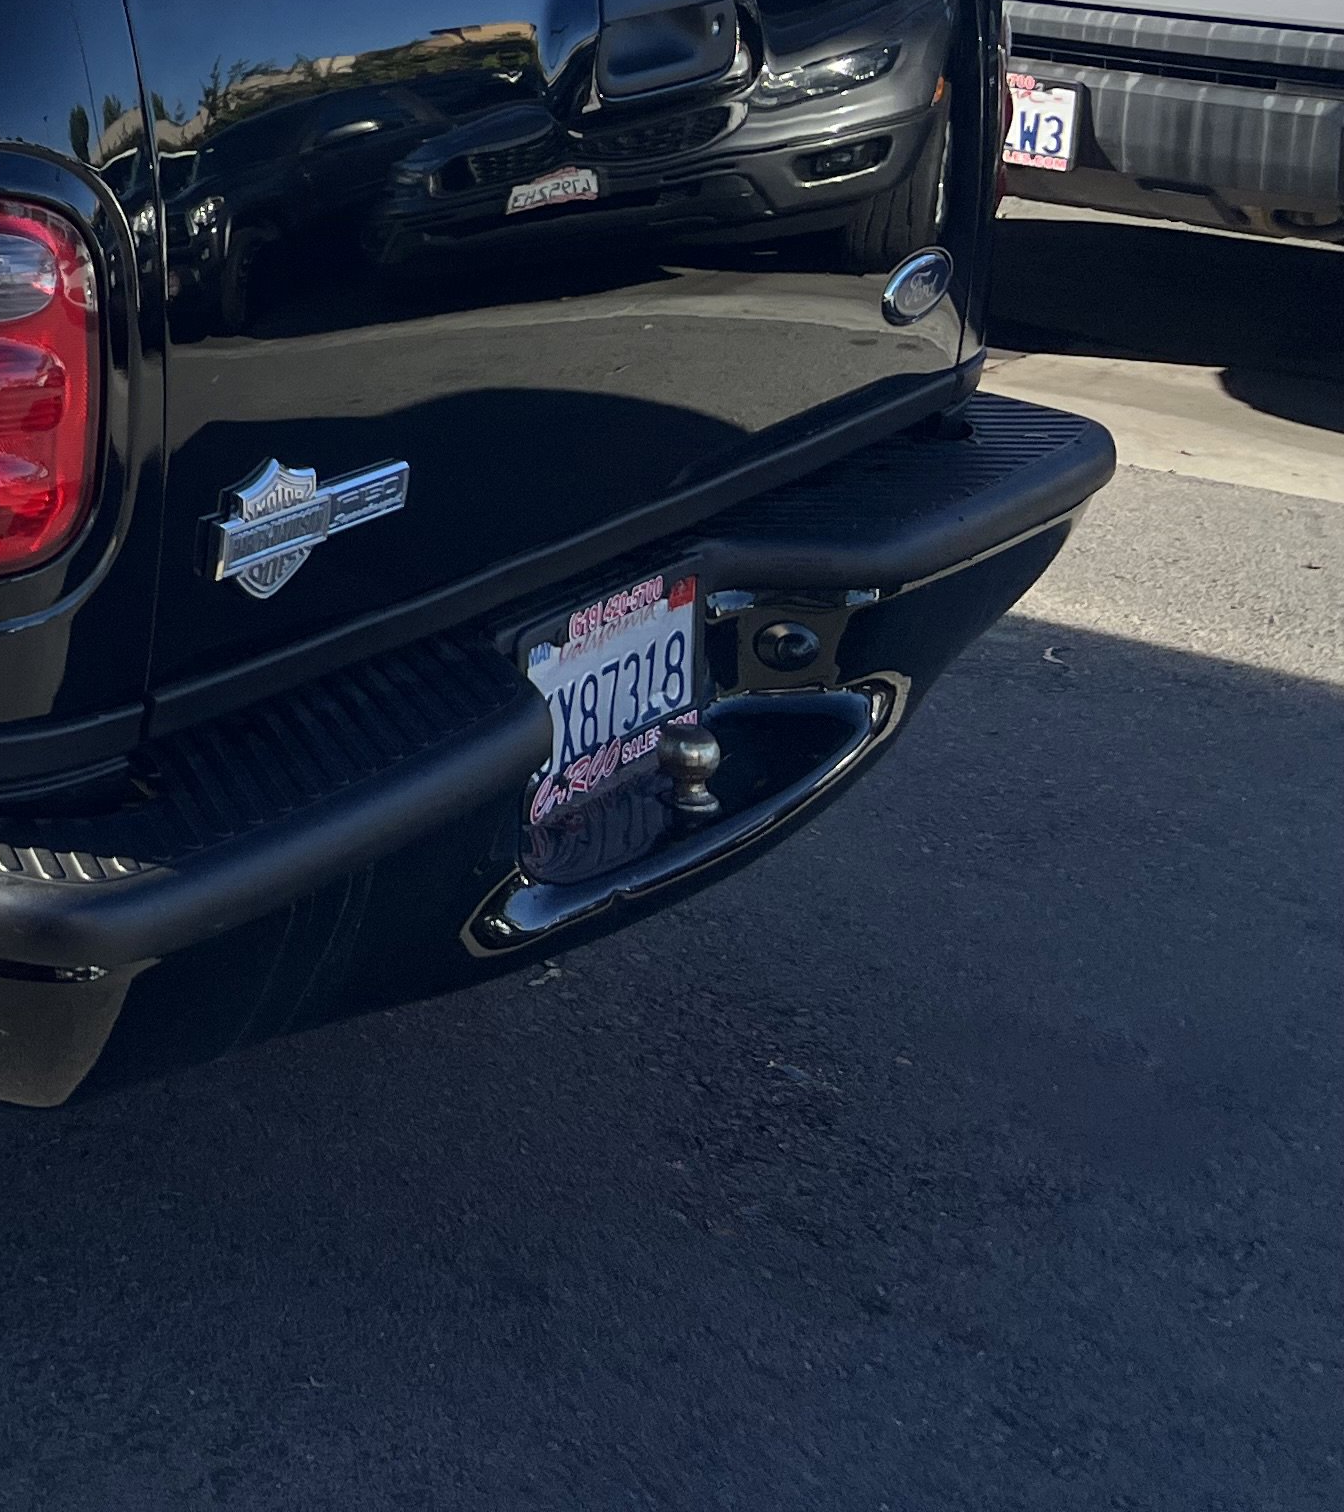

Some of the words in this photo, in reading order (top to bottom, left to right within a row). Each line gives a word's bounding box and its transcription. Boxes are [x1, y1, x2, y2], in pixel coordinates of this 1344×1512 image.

[1005, 111, 1064, 155] W3
[904, 269, 940, 306] Ford
[546, 630, 686, 763] X87318
